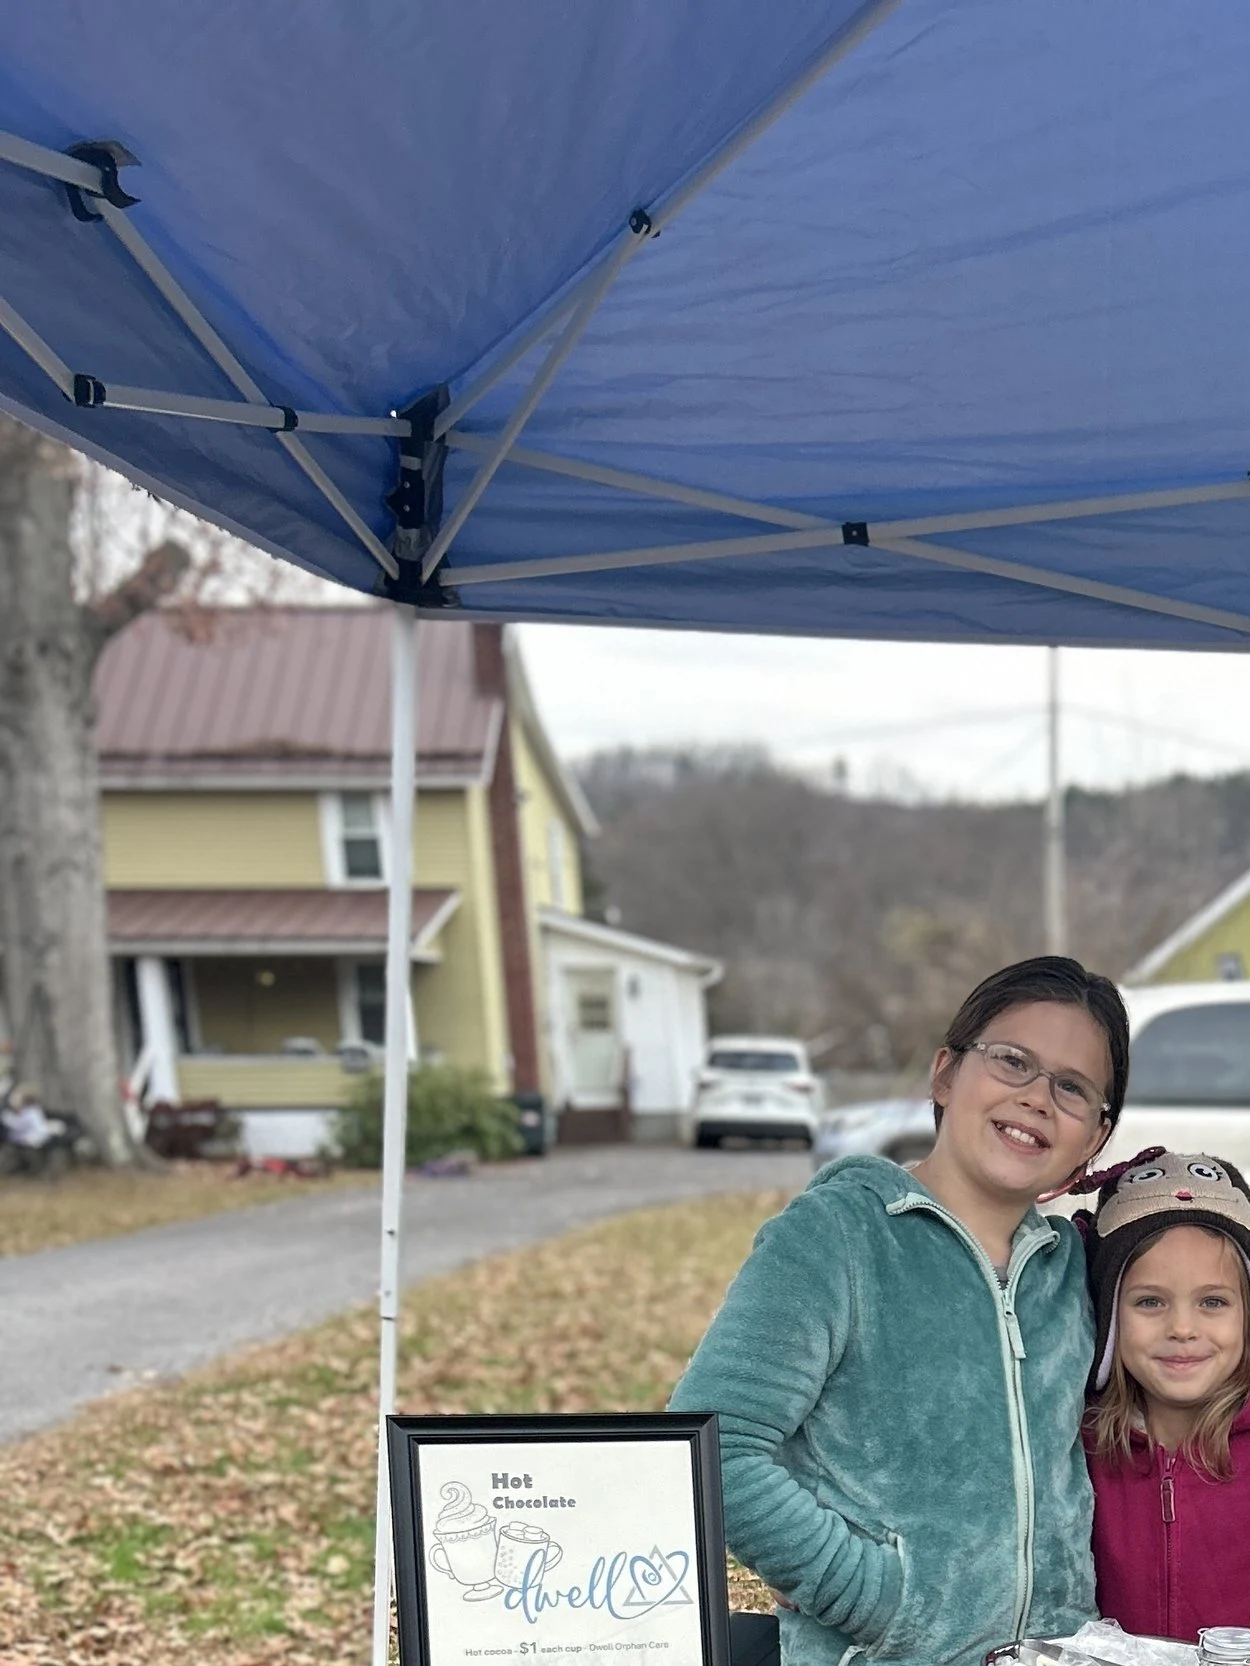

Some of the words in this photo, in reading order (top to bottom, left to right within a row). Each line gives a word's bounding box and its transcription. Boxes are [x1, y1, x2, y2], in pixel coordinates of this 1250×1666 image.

[491, 1473, 533, 1489] Hot
[492, 1496, 576, 1509] Chocolate
[504, 1549, 628, 1624] dwell
[484, 1648, 513, 1656] cocoa
[519, 1642, 537, 1656] $1
[540, 1645, 563, 1653] each
[589, 1643, 614, 1651] Dwell
[615, 1642, 647, 1651] Orphan
[648, 1641, 669, 1649] Care
